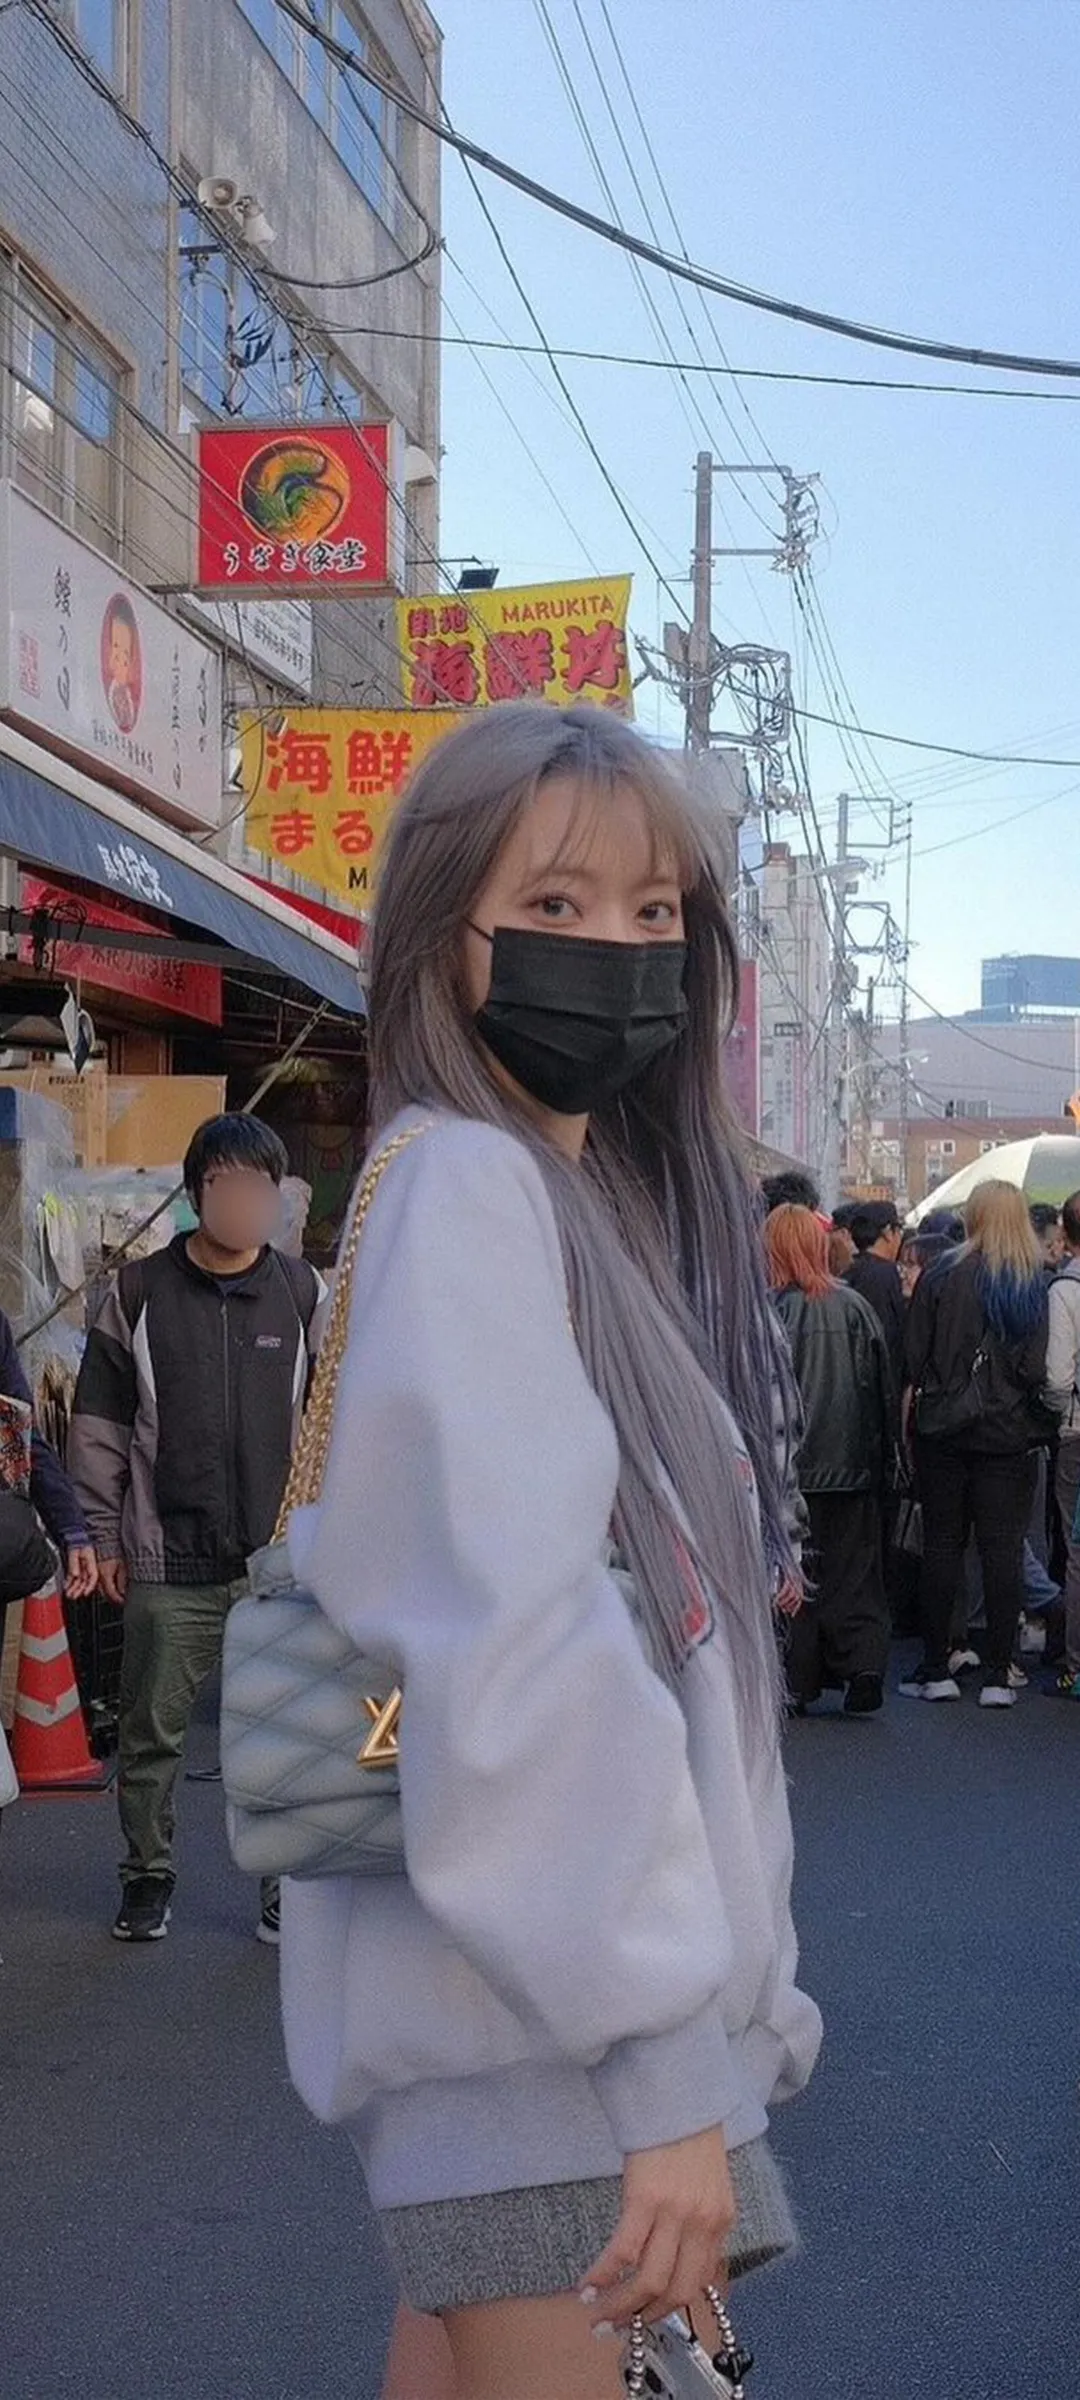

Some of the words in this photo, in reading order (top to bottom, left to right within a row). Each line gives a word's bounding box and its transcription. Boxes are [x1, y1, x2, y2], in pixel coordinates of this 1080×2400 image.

[223, 538, 366, 576] うなぎ食堂
[501, 596, 615, 624] MARUKITA
